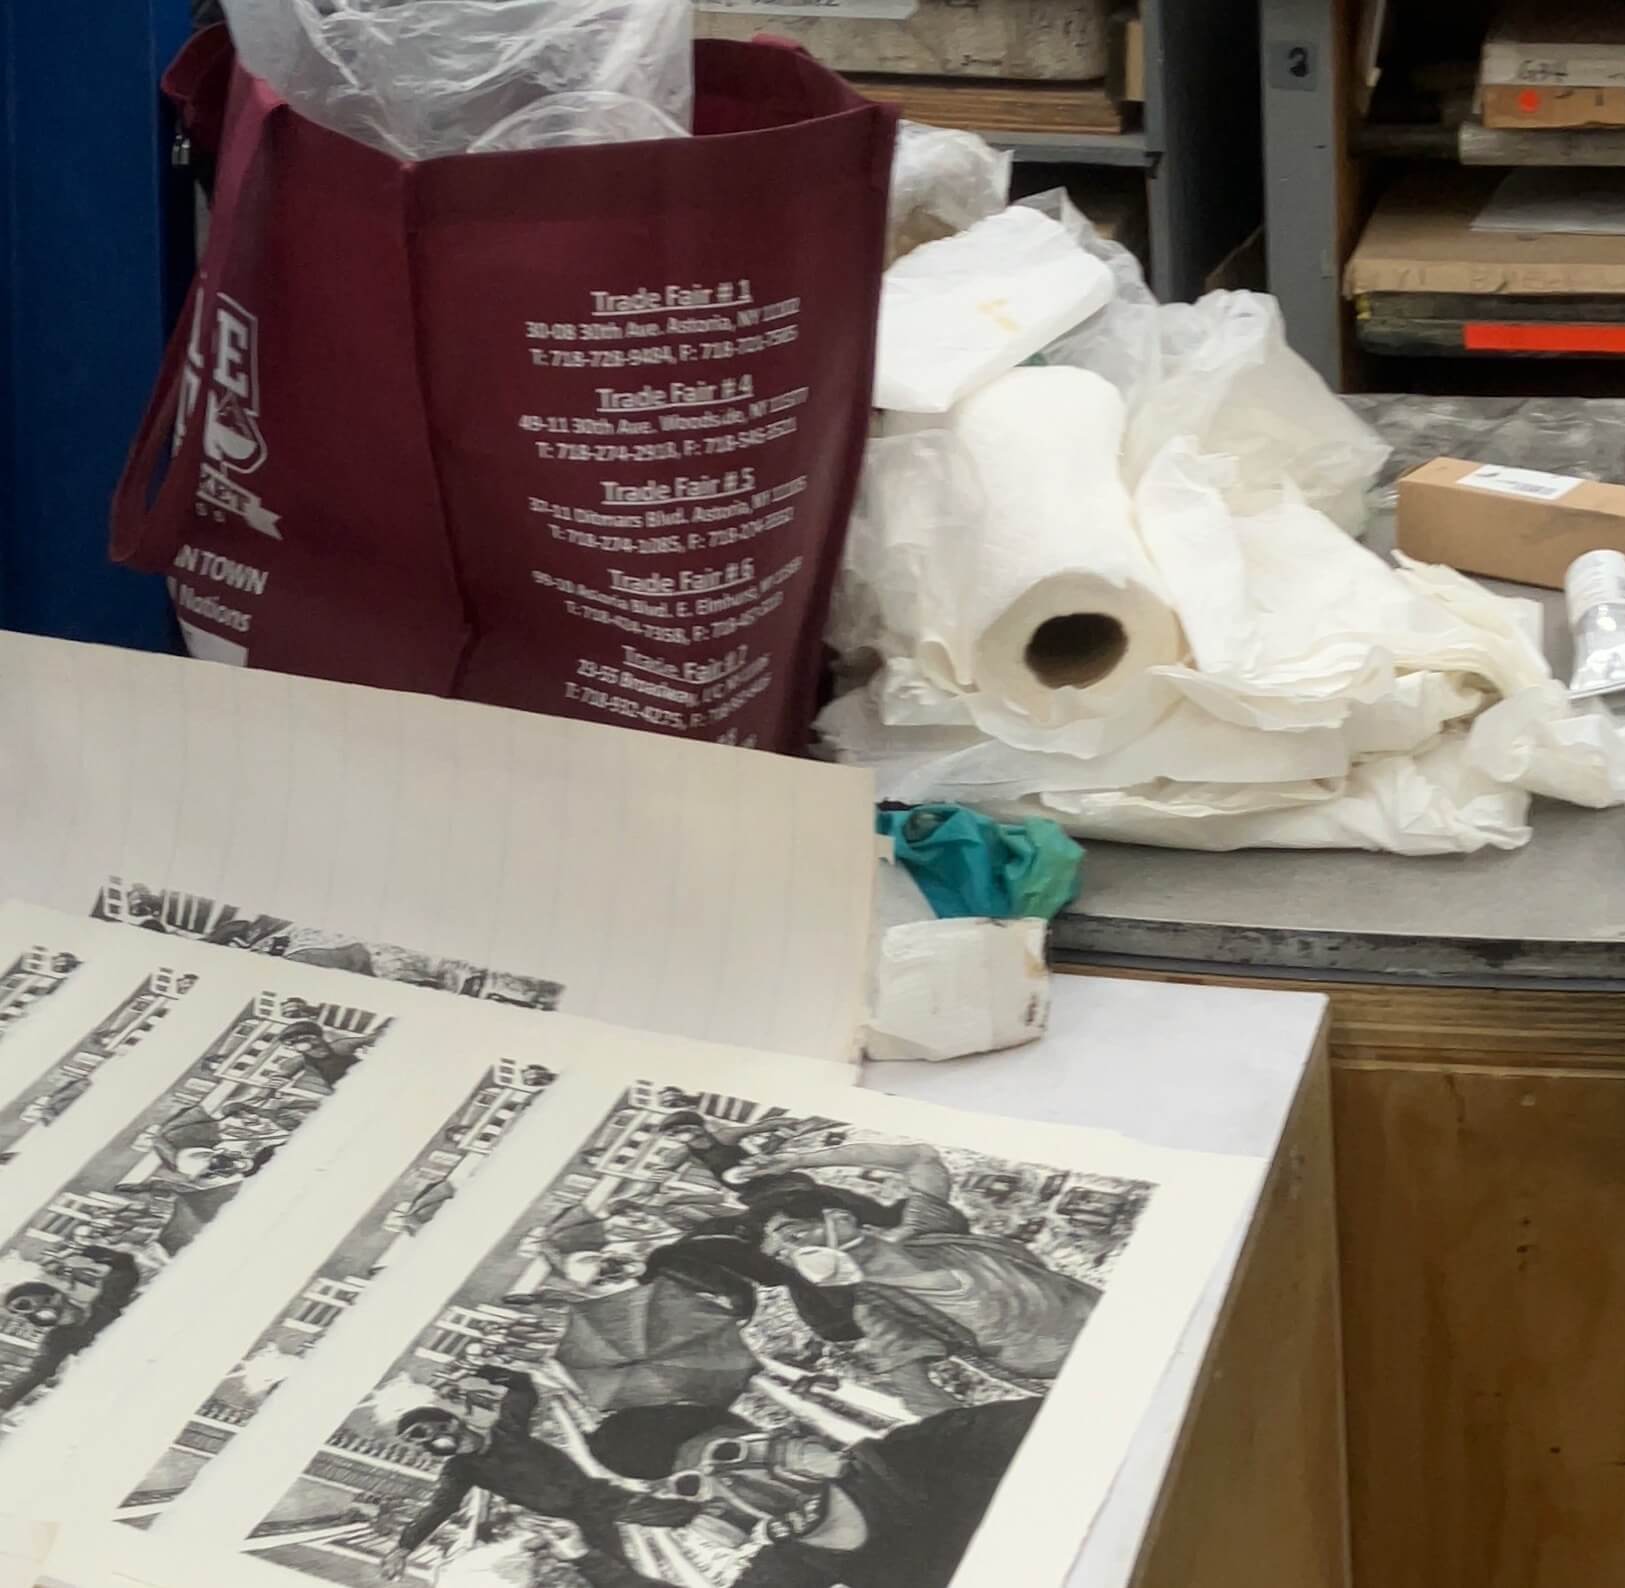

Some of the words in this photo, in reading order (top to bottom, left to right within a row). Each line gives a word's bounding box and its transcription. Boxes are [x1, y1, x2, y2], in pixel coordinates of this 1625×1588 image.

[590, 287, 661, 313] Trade
[665, 284, 713, 306] Fair
[716, 281, 735, 303] #
[738, 279, 751, 302] 1
[579, 322, 624, 341] 30th
[625, 322, 666, 338] Ave.
[666, 314, 736, 335] Astoria,
[736, 309, 761, 329] NY
[595, 384, 667, 409] Trade
[670, 381, 717, 403] Fair
[720, 377, 737, 399] #
[738, 374, 754, 395] 4
[572, 417, 615, 435] 30th
[616, 418, 657, 435] Ave.
[600, 480, 671, 502] Trade
[674, 475, 721, 498] Fair
[723, 470, 739, 493] #
[740, 467, 756, 489] 5
[200, 551, 269, 595] TOWN
[607, 568, 675, 594] Trade
[679, 568, 723, 591] Fair
[621, 644, 680, 679] Trade
[683, 655, 726, 682] Fair
